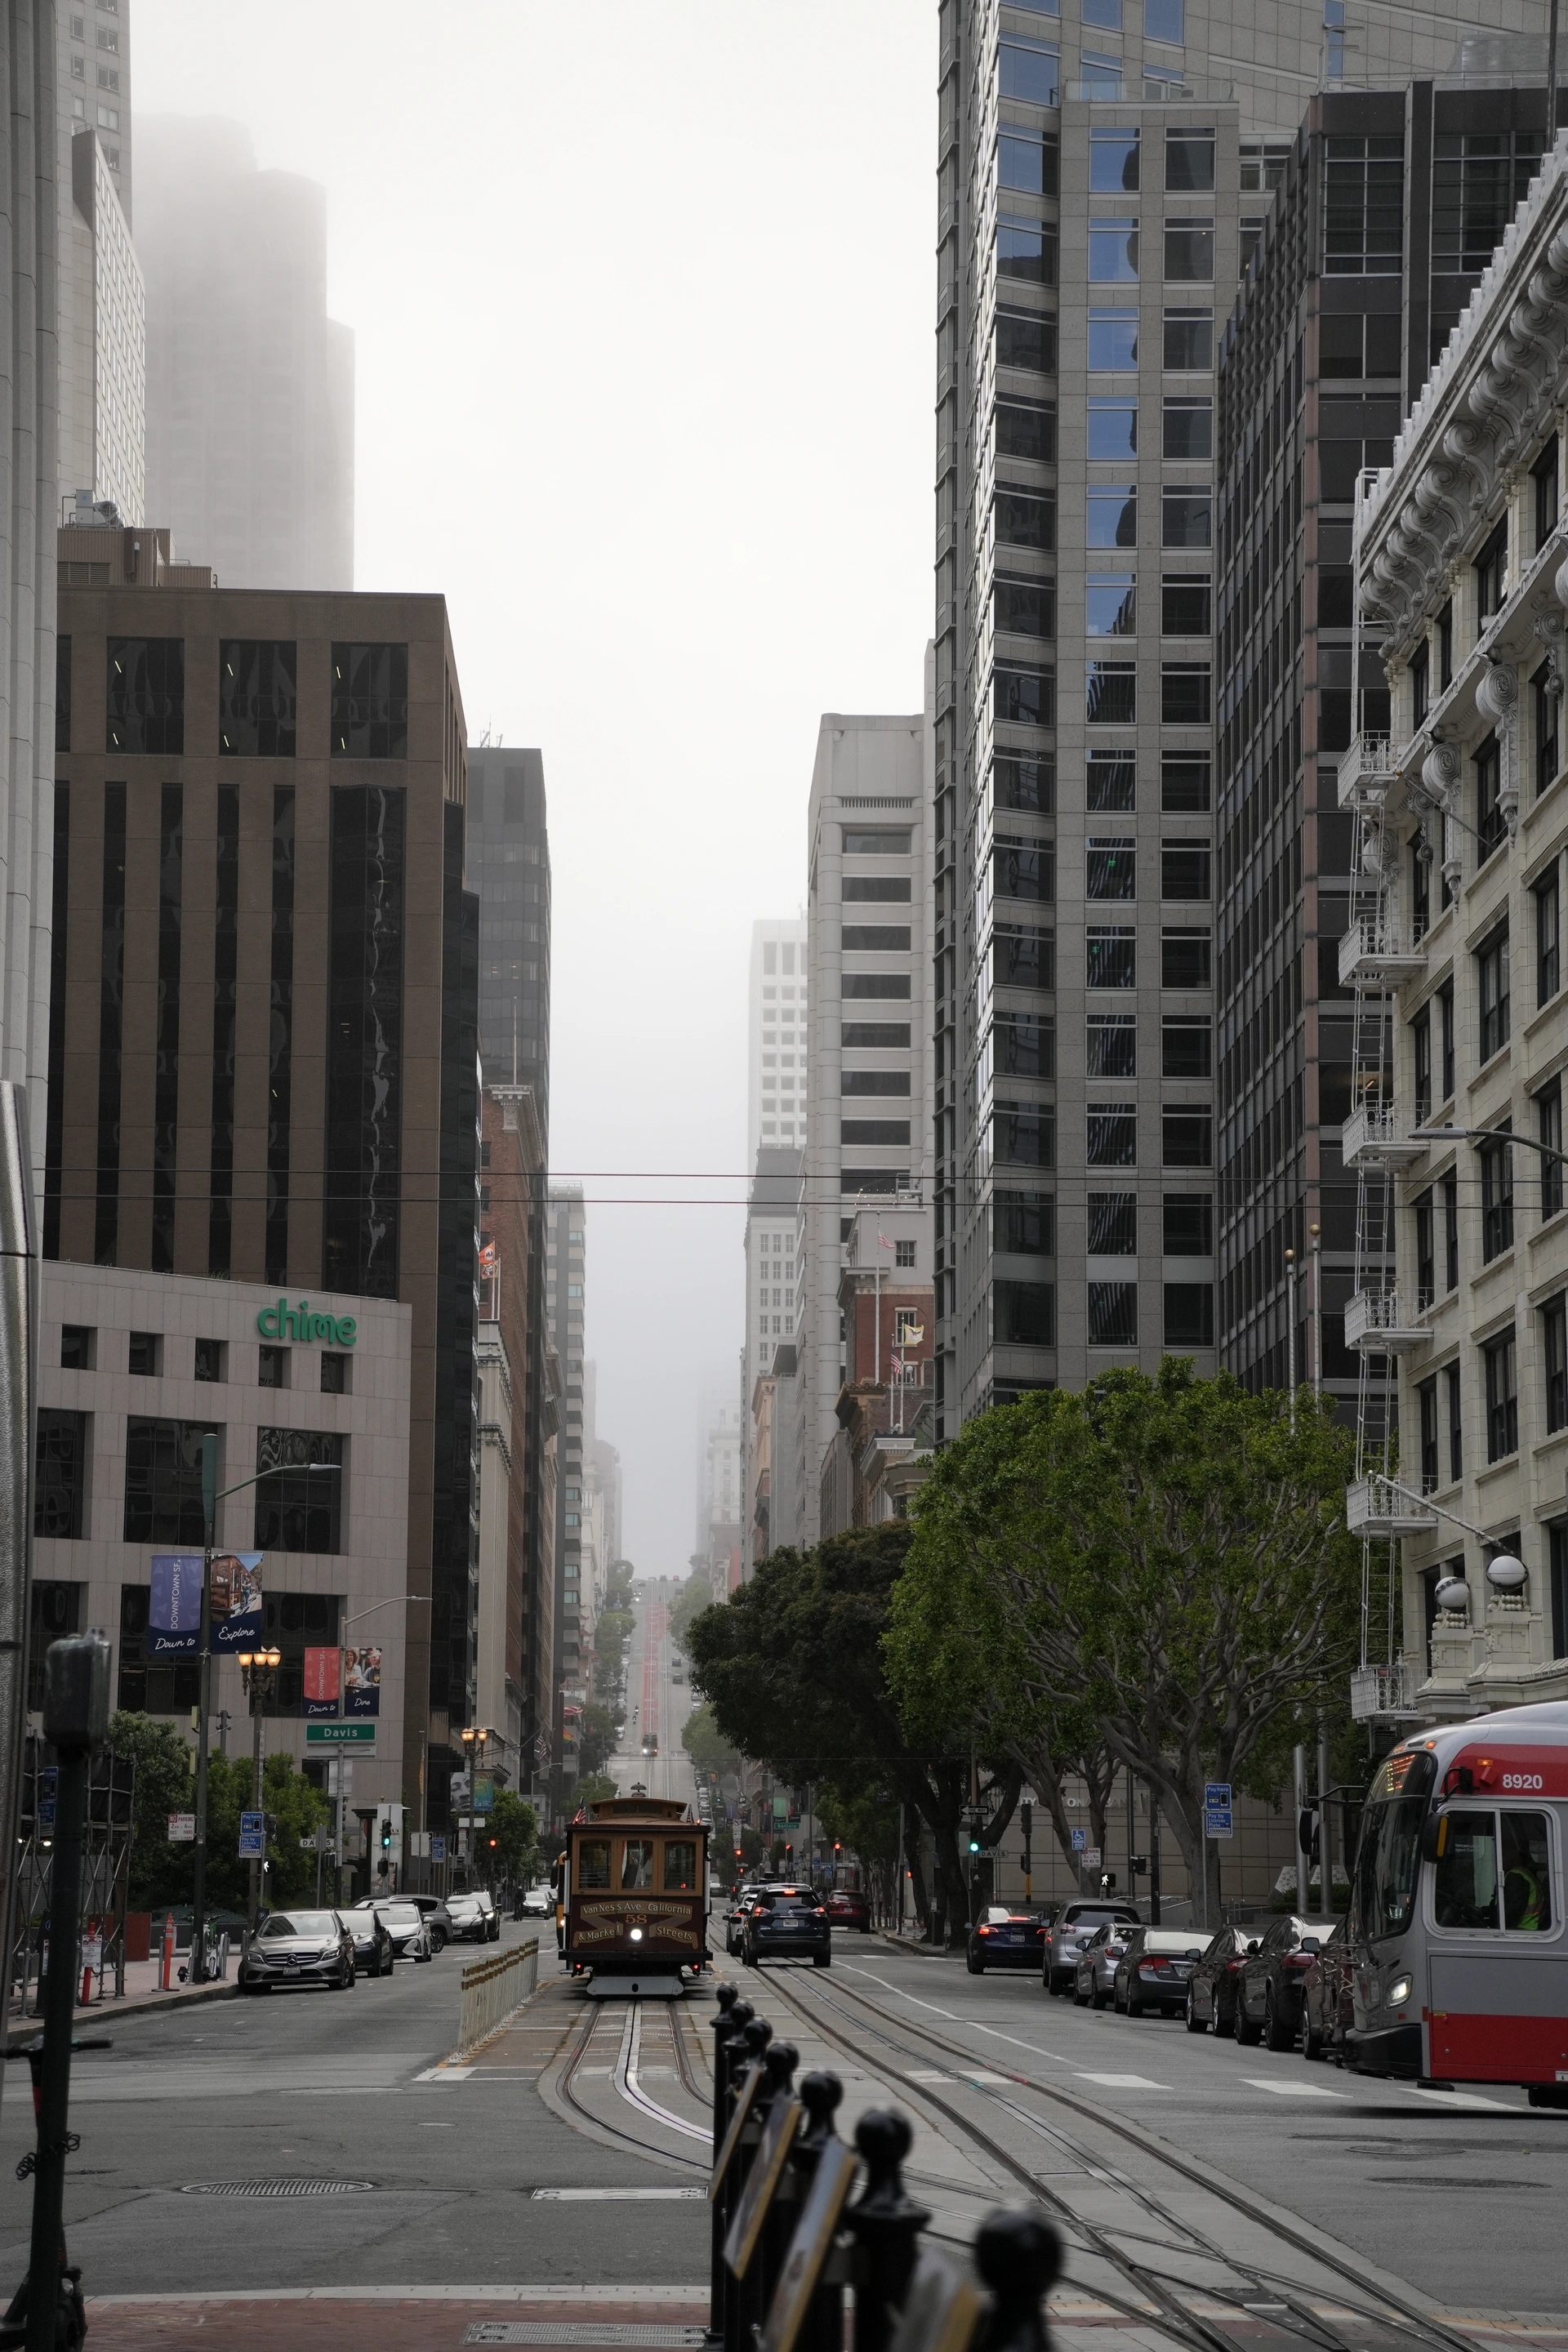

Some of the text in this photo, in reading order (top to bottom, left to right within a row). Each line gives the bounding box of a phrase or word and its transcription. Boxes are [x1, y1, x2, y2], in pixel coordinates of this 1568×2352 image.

[257, 1298, 357, 1345] chime
[171, 1562, 180, 1629] DOWNTOWN SF
[218, 1626, 256, 1642] Explore
[155, 1637, 195, 1650] Down to
[354, 1698, 371, 1707] Dine
[308, 1704, 328, 1714] Down
[323, 1727, 358, 1737] Davis
[1503, 1774, 1543, 1789] 8920
[169, 1815, 177, 1823] NO
[302, 1838, 331, 1846] DAS
[582, 1906, 599, 1914] Van
[599, 1903, 621, 1913] Ness
[648, 1903, 692, 1915] California
[625, 1913, 648, 1924] 58
[578, 1925, 620, 1941] & Market
[657, 1927, 693, 1940] Streets
